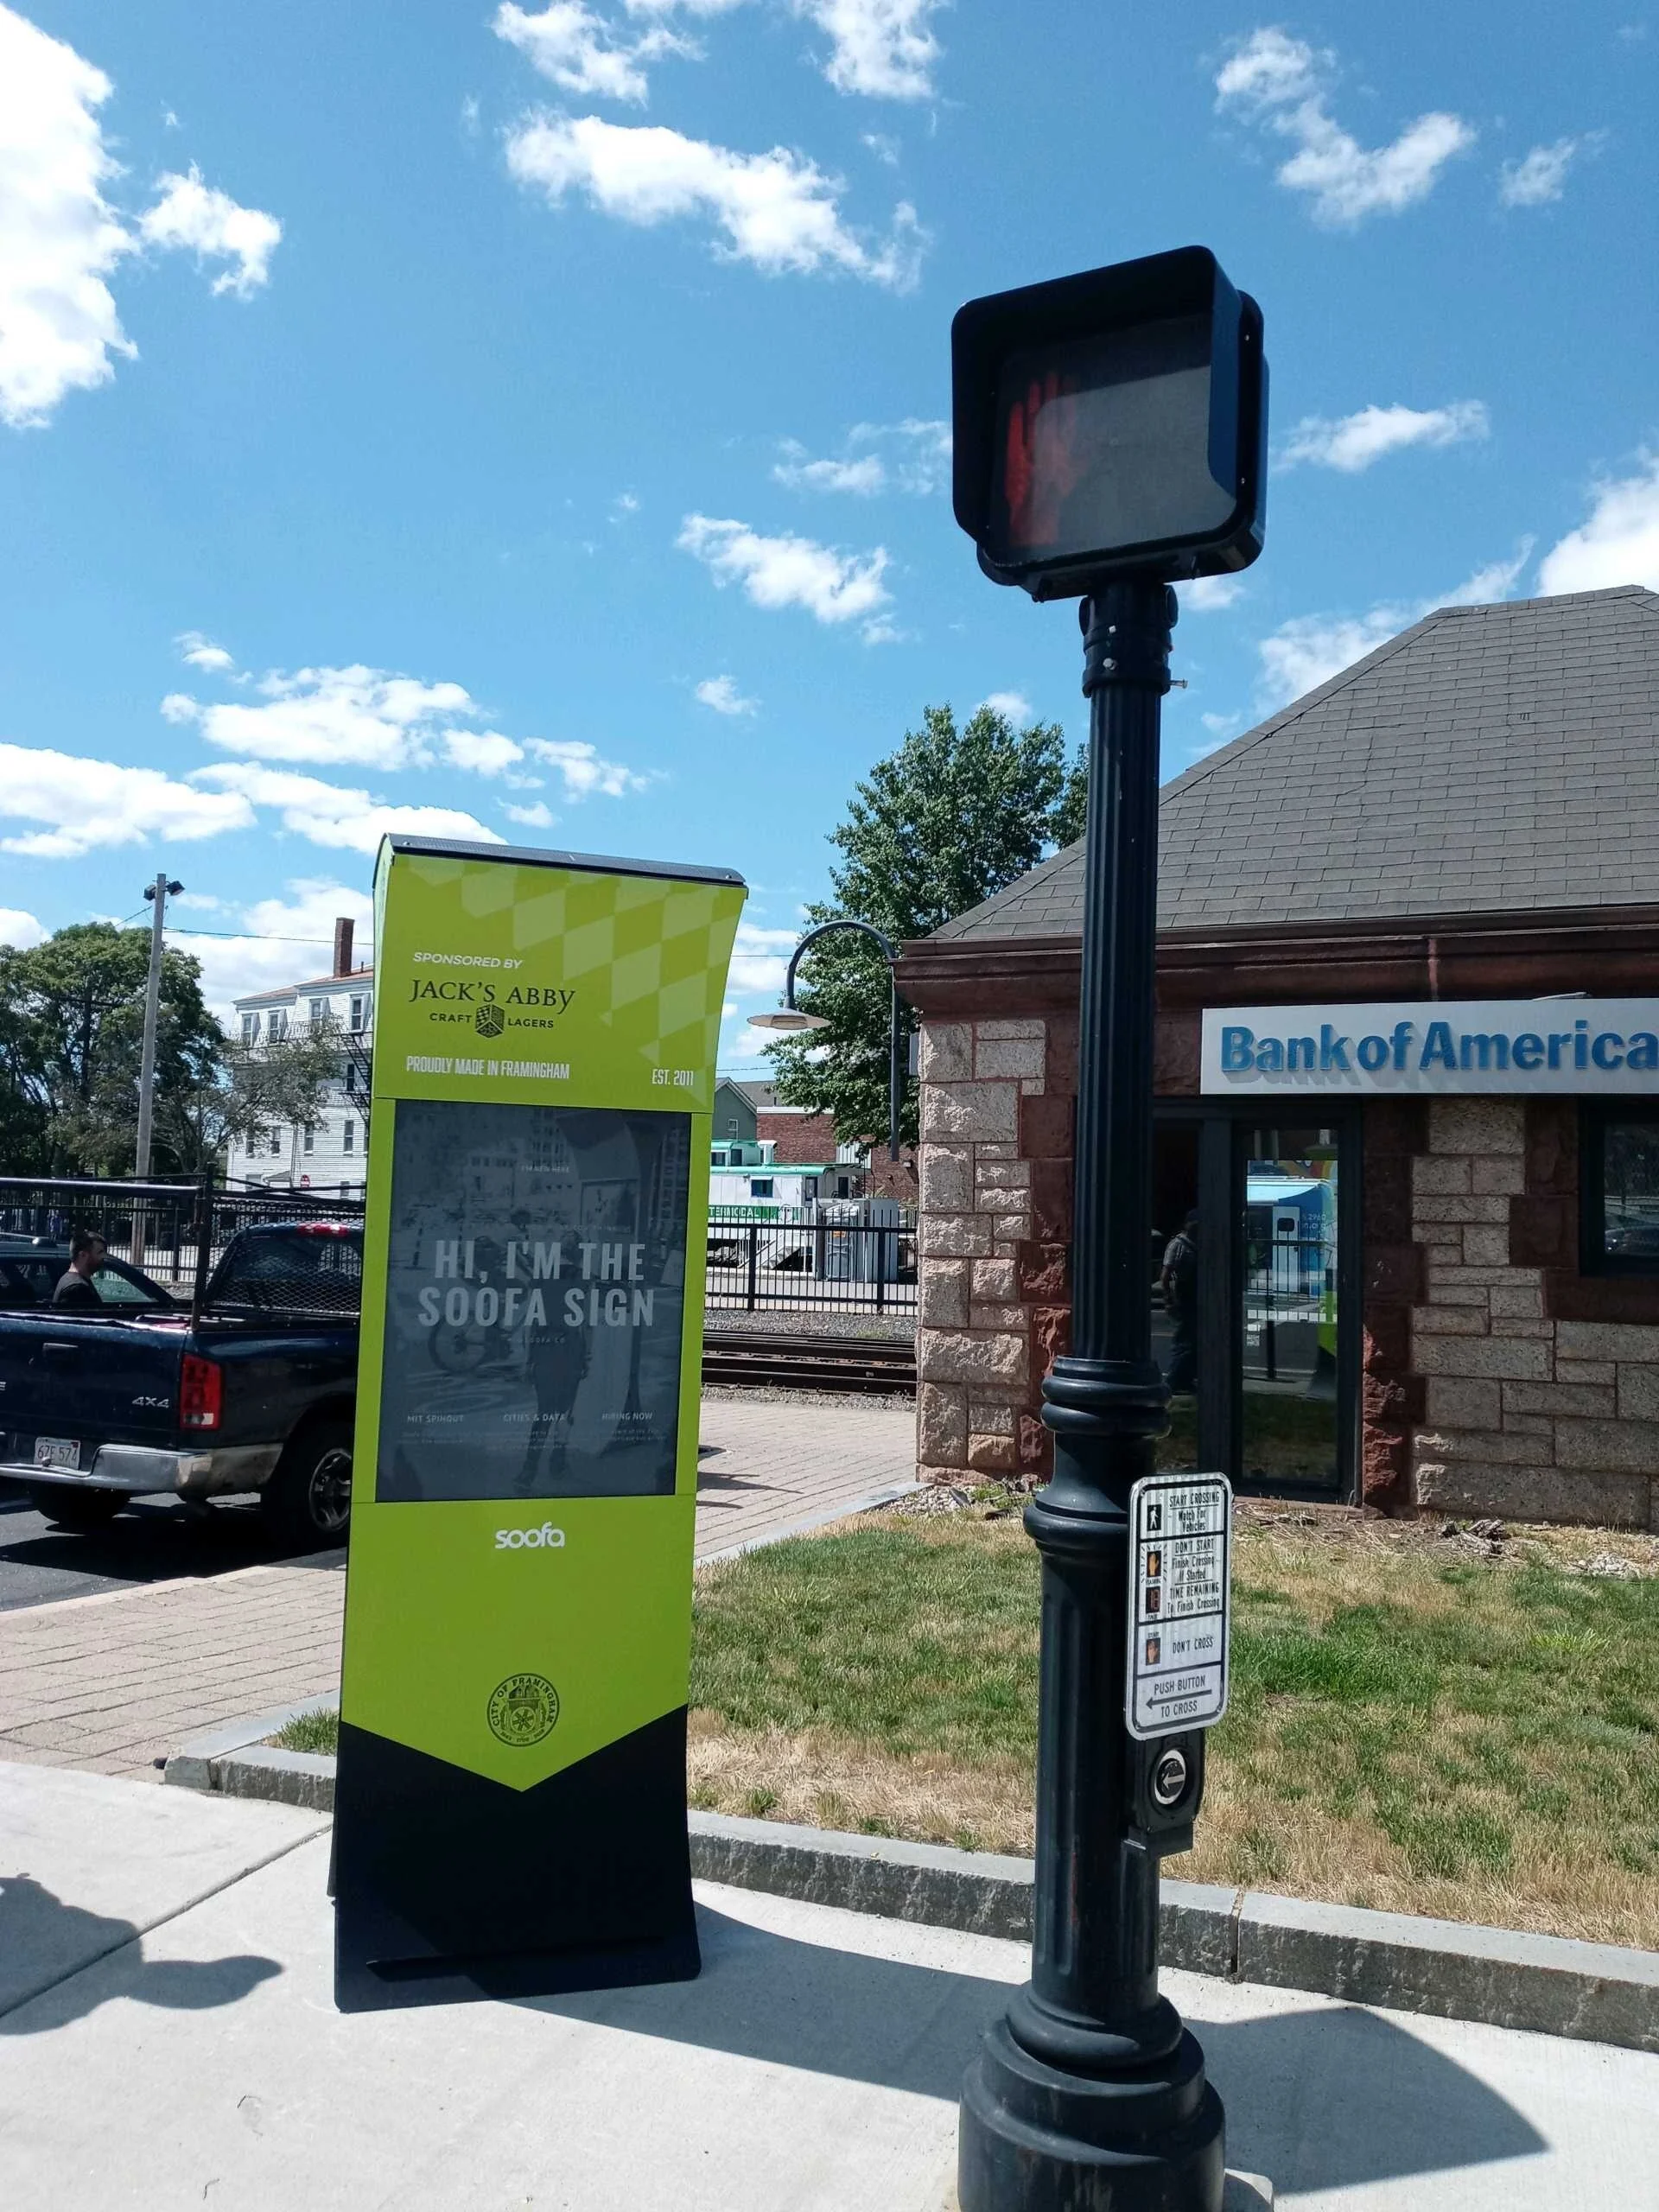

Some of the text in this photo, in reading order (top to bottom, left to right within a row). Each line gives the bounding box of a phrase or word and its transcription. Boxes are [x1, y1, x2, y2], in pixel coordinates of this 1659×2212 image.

[413, 952, 524, 969] SPONSORED BY
[409, 979, 575, 1015] JACK'S ABBY
[429, 1012, 554, 1028] CRAFT LAGERS
[1221, 1023, 1350, 1072] Bank
[1357, 1020, 1414, 1071] of
[406, 1055, 570, 1079] PROUDLY MADE IN FRAMINGHAM
[651, 1069, 694, 1086] EST. 2011
[435, 1240, 645, 1284] HI, I'M THE
[418, 1287, 654, 1328] SOOFA SIGN
[407, 1414, 423, 1424] MIT
[632, 1411, 654, 1421] NOW
[1169, 1491, 1220, 1507] START CROSSING
[1178, 1507, 1207, 1522] Watch For
[495, 1521, 566, 1548] soofa
[1182, 1520, 1206, 1533] Vehicles
[1175, 1538, 1215, 1554] DON'T START
[1172, 1554, 1215, 1569] Finish Crossing
[1179, 1568, 1206, 1582] If Started
[1170, 1581, 1220, 1599] TIME REMAINING
[1177, 1599, 1194, 1612] Finish
[1197, 1597, 1220, 1611] Crossing
[1173, 1637, 1214, 1654] DON'T CROSS
[1154, 1675, 1206, 1695] PUSH BUTTON
[491, 1700, 500, 1726] CITY
[497, 1684, 508, 1698] OF
[1160, 1700, 1198, 1718] TO CROSS
